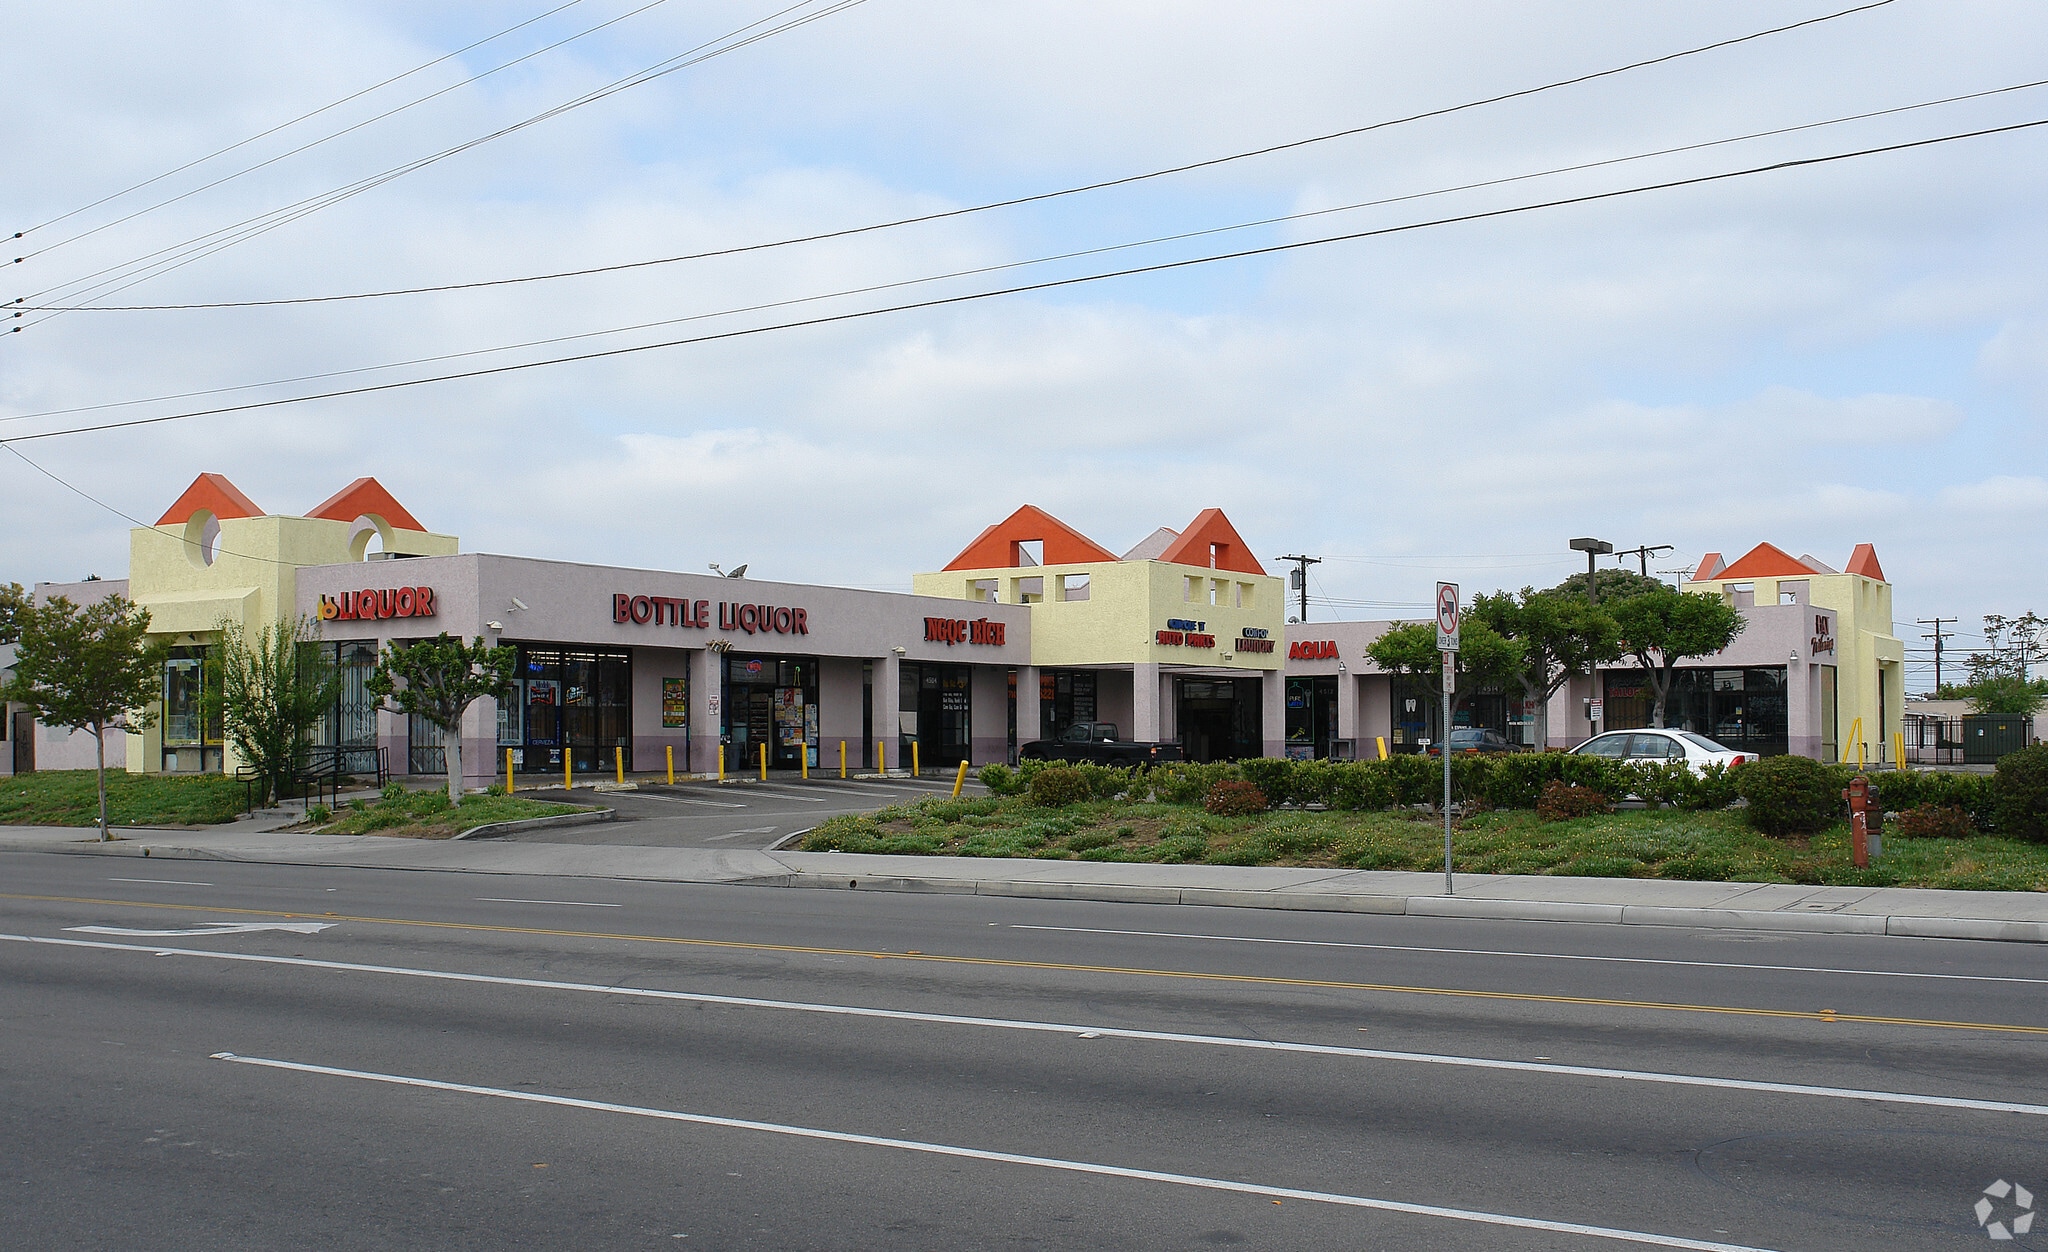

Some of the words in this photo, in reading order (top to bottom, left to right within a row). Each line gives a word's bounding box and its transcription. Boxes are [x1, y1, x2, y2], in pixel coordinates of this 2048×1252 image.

[339, 586, 435, 620] LIQUOR
[613, 593, 710, 629] BOTTLE
[719, 601, 810, 635] LIQUOR
[924, 617, 968, 646] NGỌC
[969, 617, 1006, 646] BÍCH
[1156, 630, 1184, 646] AUTO
[1185, 633, 1215, 648] PARTS
[1235, 638, 1276, 653] LAUNDRY
[1288, 640, 1340, 660] AGUA
